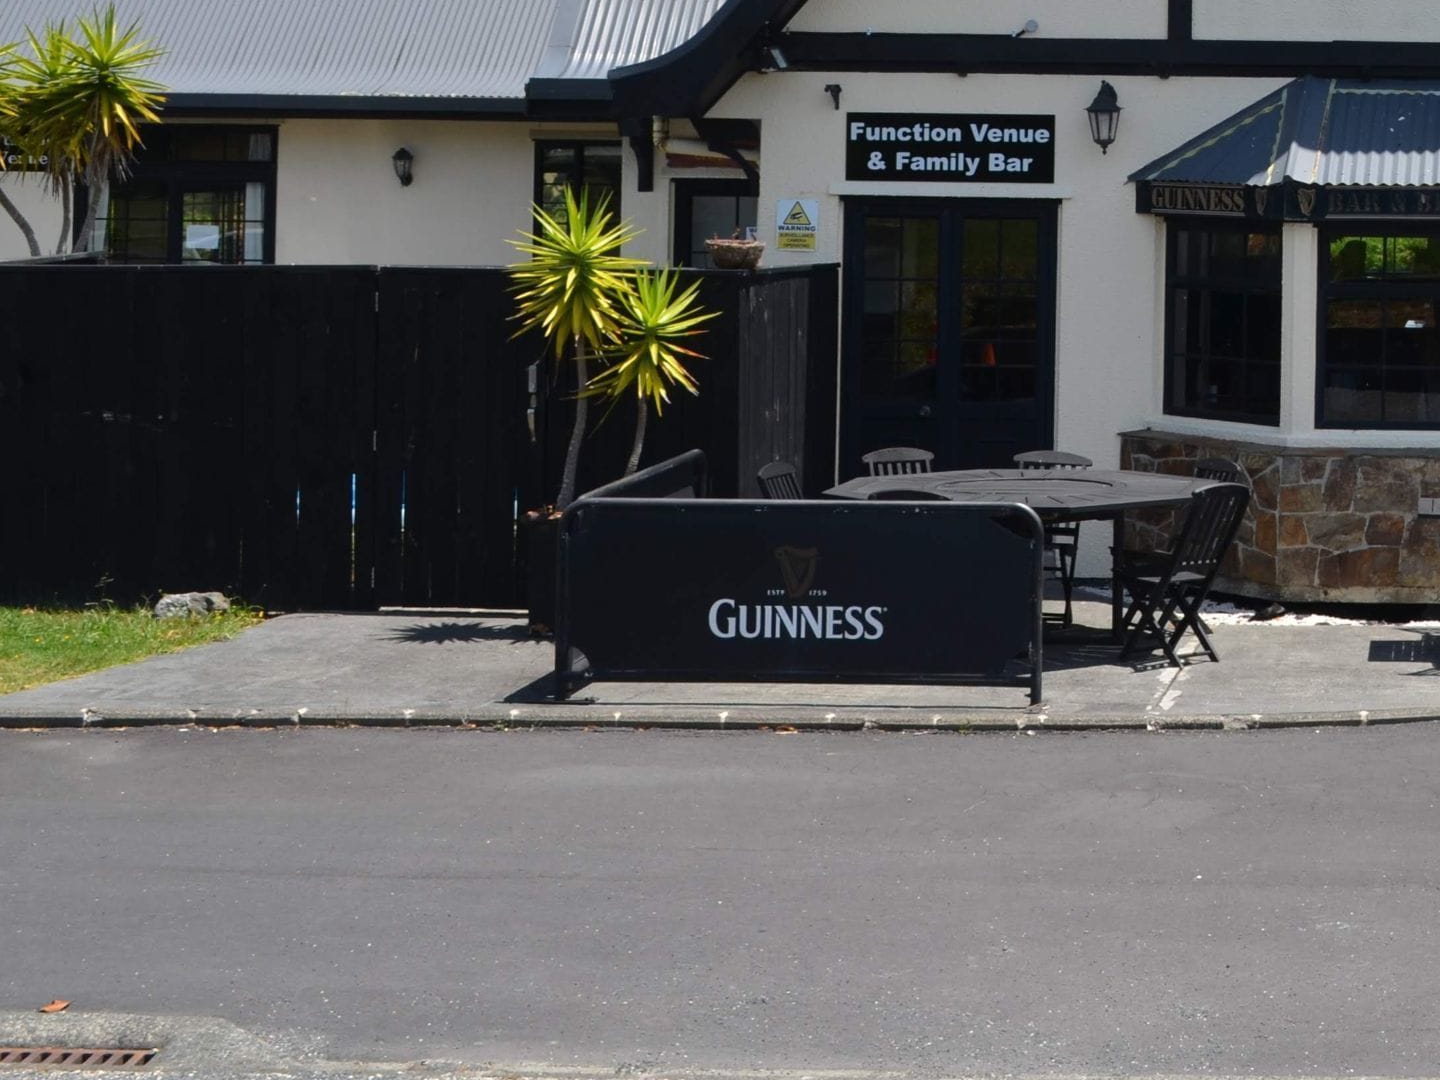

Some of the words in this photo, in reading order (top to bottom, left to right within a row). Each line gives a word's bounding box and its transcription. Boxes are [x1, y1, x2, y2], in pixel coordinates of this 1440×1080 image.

[850, 122, 962, 143] Function
[970, 124, 1050, 144] Venue
[867, 151, 887, 171] &
[895, 151, 981, 177] Family
[988, 153, 1034, 172] Bar
[1151, 186, 1245, 211] GUINNESS
[1327, 192, 1382, 213] BAR
[808, 589, 828, 597] 1759
[708, 598, 885, 640] GUINNESS
